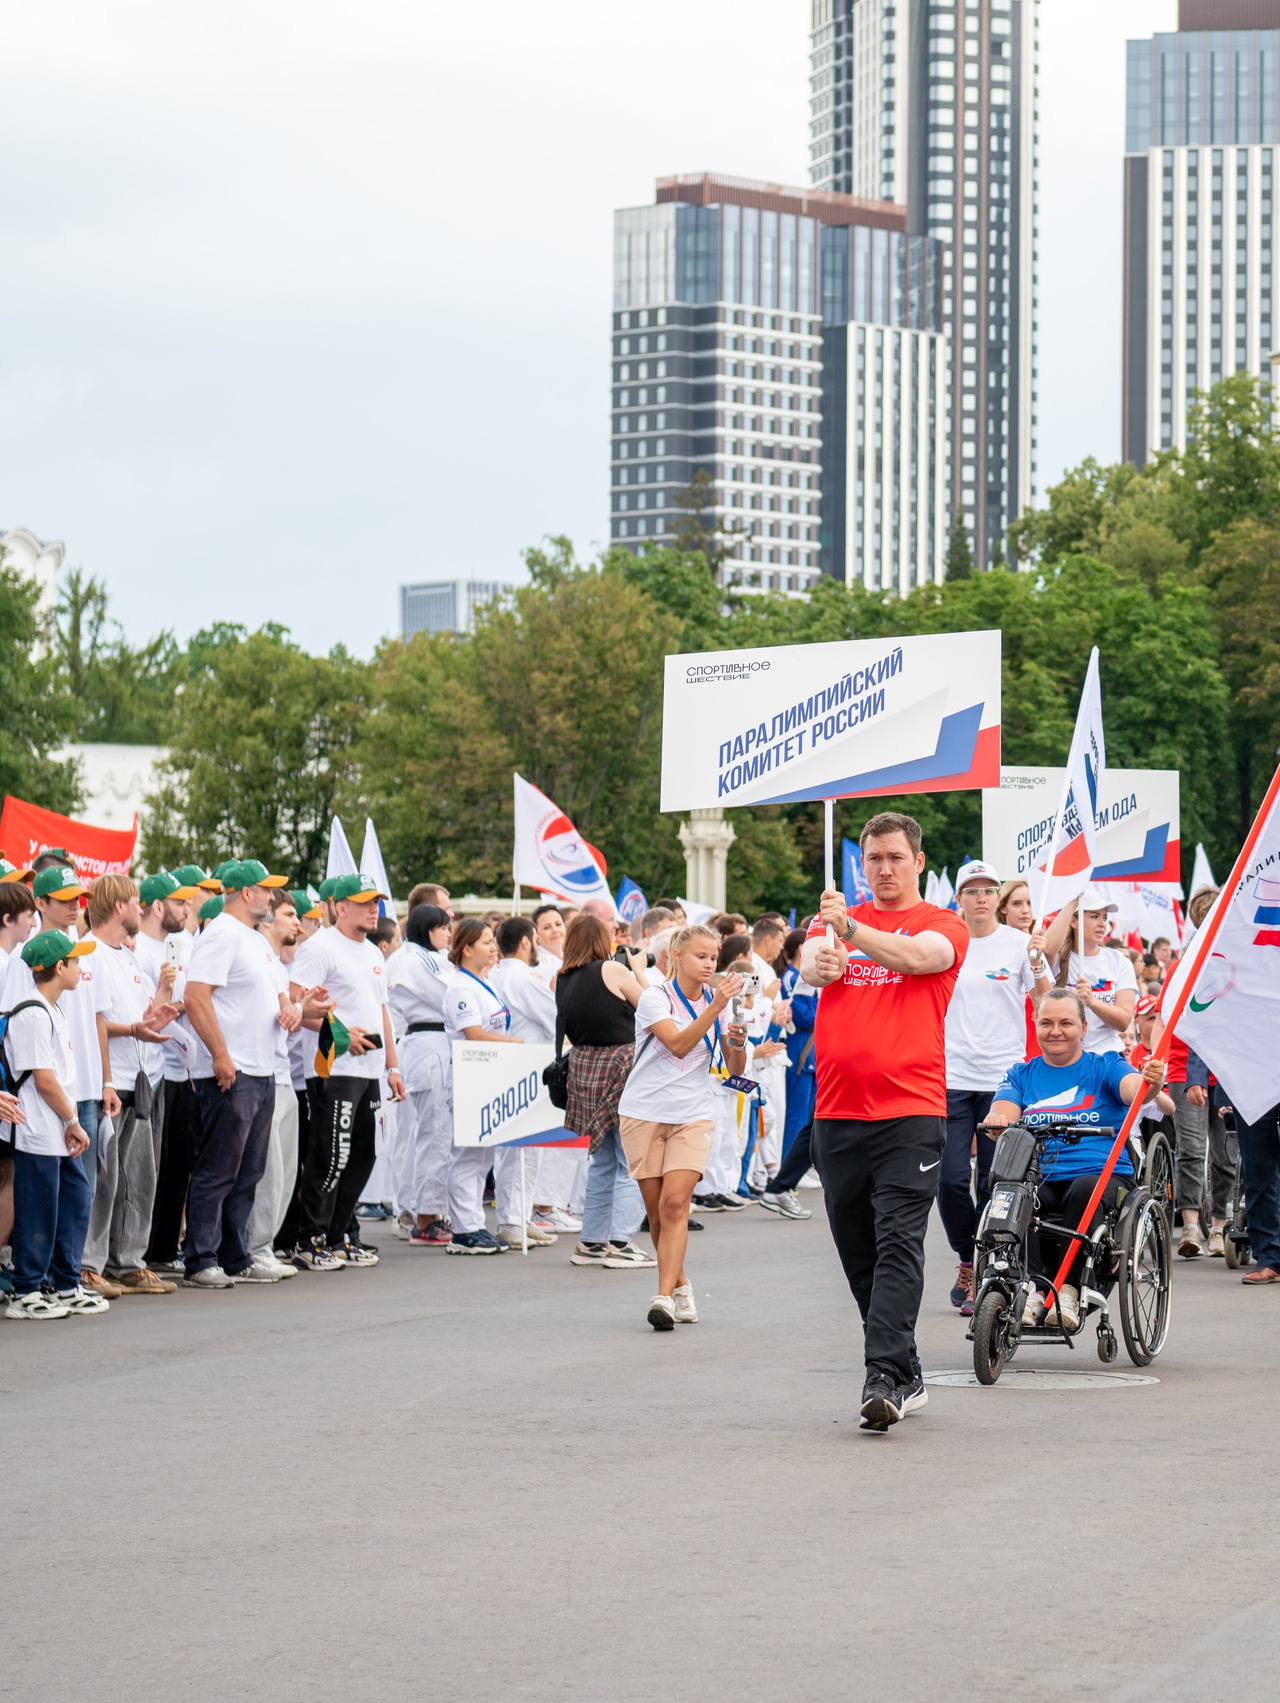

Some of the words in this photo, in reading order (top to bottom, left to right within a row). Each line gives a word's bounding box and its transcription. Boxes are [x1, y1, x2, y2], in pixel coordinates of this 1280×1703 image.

[686, 673, 751, 684] ШЕСТВИЕ
[718, 646, 904, 768] ПАРАЛИМПИЙСКИЙ
[717, 729, 807, 799] КОМИТЕТ
[811, 687, 886, 749] РОССИИ
[1112, 792, 1138, 821] ОДА
[29, 839, 38, 855] У
[1017, 815, 1055, 851] СПОРТ
[843, 975, 904, 987] ШЕСТВИЕ
[340, 1100, 353, 1130] NO
[478, 1070, 539, 1143] ДЗЮДО
[1023, 1111, 1101, 1125] ПОРТИВНОЕ
